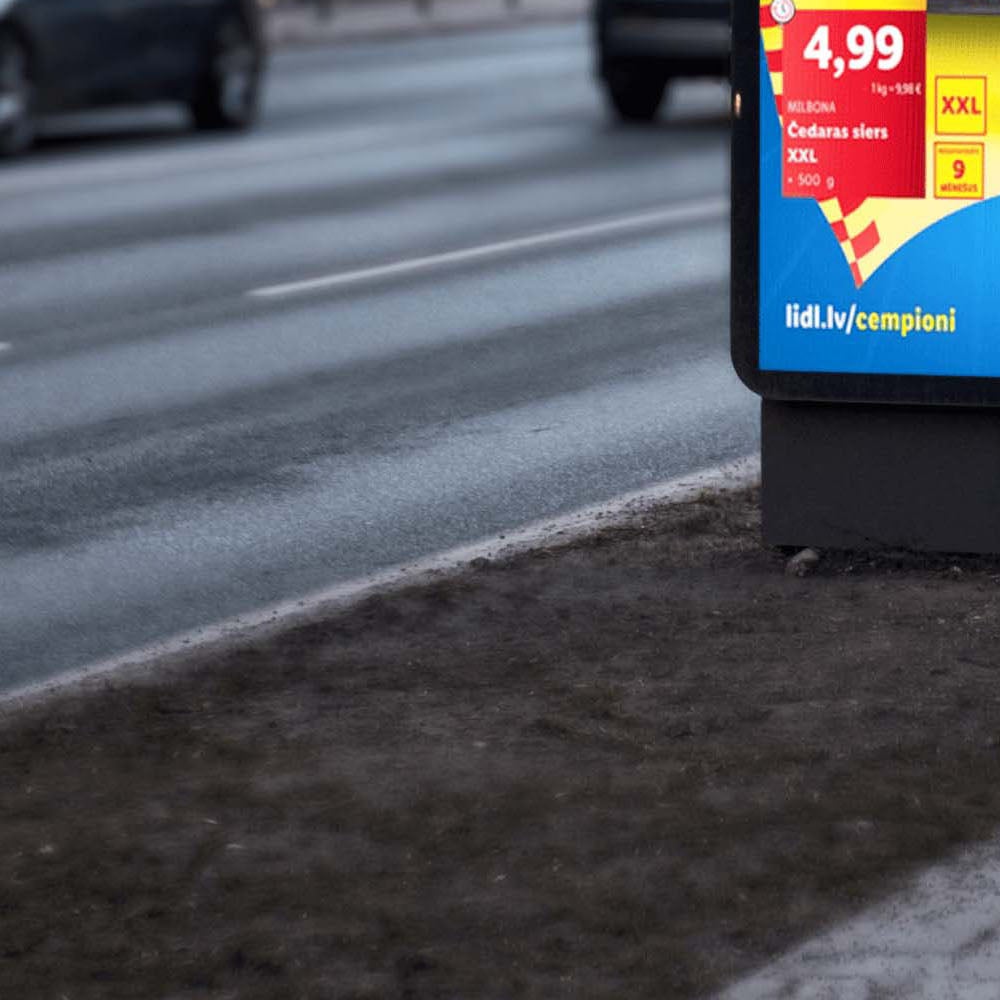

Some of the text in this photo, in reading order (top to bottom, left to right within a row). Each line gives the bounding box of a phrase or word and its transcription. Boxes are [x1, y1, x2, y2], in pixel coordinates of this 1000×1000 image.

[802, 24, 904, 78] 4,99
[787, 101, 836, 113] MILBONA
[942, 95, 982, 115] XXL
[787, 120, 888, 139] Čedaras siers
[787, 148, 818, 163] XXL
[952, 159, 965, 179] 9
[798, 174, 835, 189] 500 g
[785, 303, 956, 337] lidl.lv/cempioni
